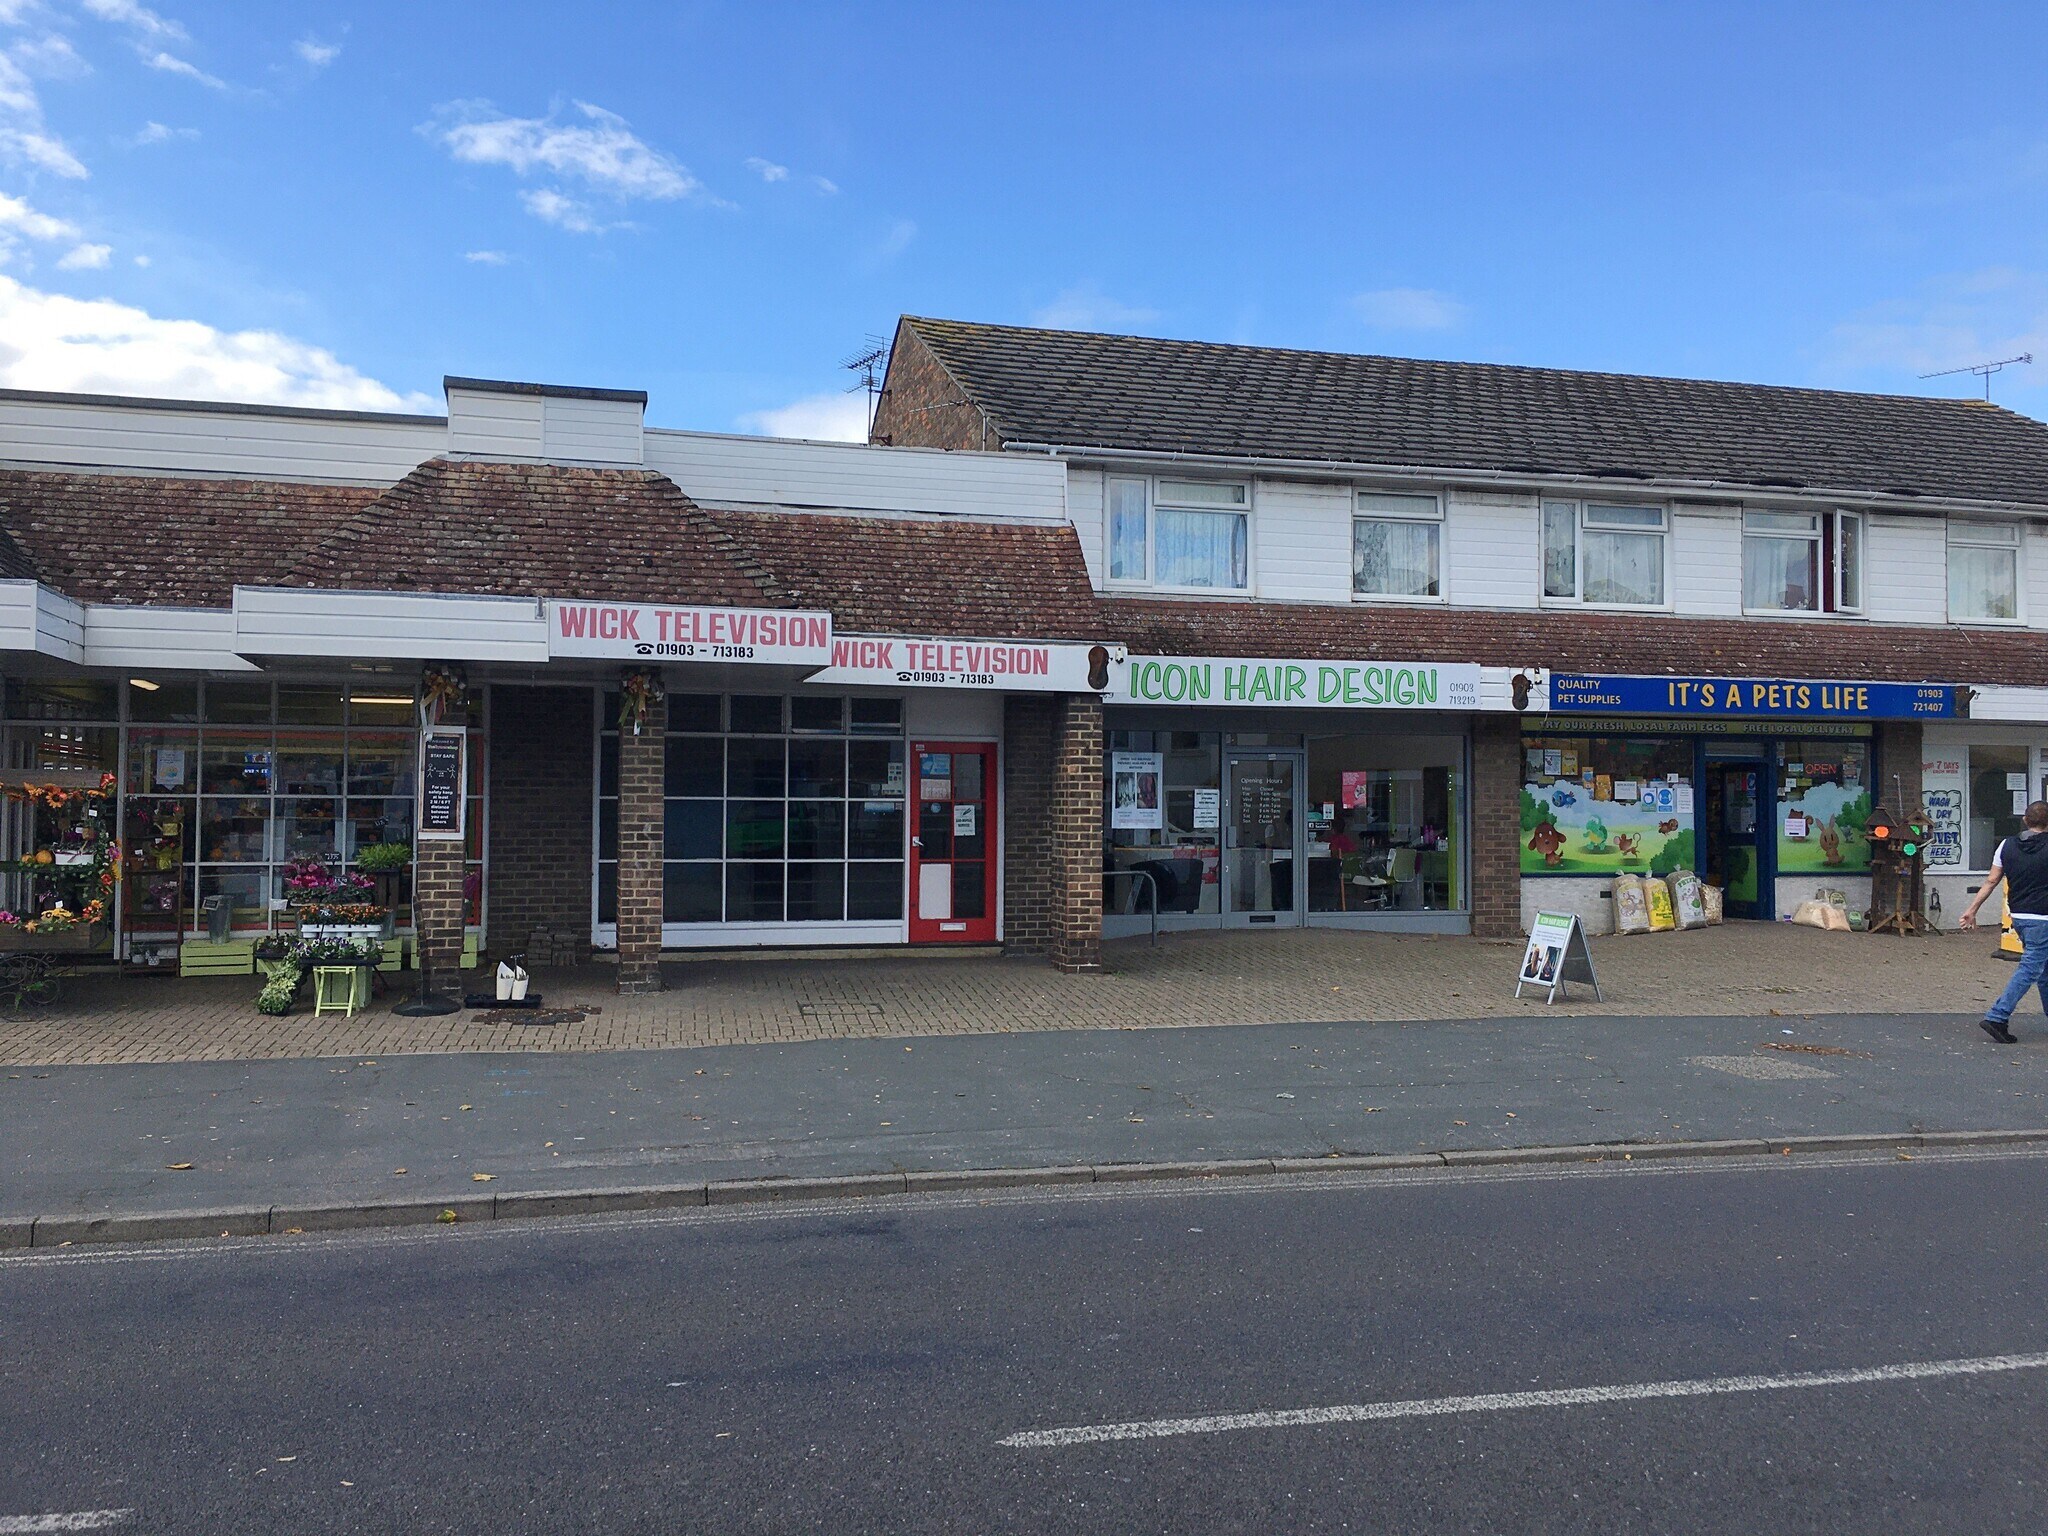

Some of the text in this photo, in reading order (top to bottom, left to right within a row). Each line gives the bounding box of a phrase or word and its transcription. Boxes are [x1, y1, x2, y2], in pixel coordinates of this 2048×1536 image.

[559, 606, 827, 647] WICK TELEVISION
[657, 643, 695, 656] 01903
[712, 645, 754, 659] 713183
[832, 640, 1048, 675] WICK TELEVISION
[913, 671, 945, 683] 01903
[959, 673, 994, 685] 713183
[1130, 662, 1438, 705] ICON HAIR DESIGN
[1450, 682, 1474, 692] 01903
[1557, 679, 1601, 690] QUALITY
[1668, 682, 1869, 710] IT'S A PETS LIFE
[1917, 688, 1943, 698] 01903
[1449, 695, 1476, 705] 713219
[1557, 694, 1621, 705] PET SUPPLIES
[1913, 702, 1943, 712] 721407
[1564, 721, 1589, 730] OUR
[1631, 722, 1664, 731] LOCAL
[1667, 722, 1697, 731] FARM
[1700, 723, 1727, 732] EGGS
[1743, 724, 1855, 734] FREE LOCAL DELIVERY
[1805, 763, 1837, 774] OPEN
[1937, 761, 1942, 770] 7
[1944, 761, 1959, 770] DAYS
[1241, 777, 1263, 785] Opening
[1929, 797, 1950, 807] WASH
[1936, 810, 1953, 819] DRY
[1930, 848, 1951, 856] HERE
